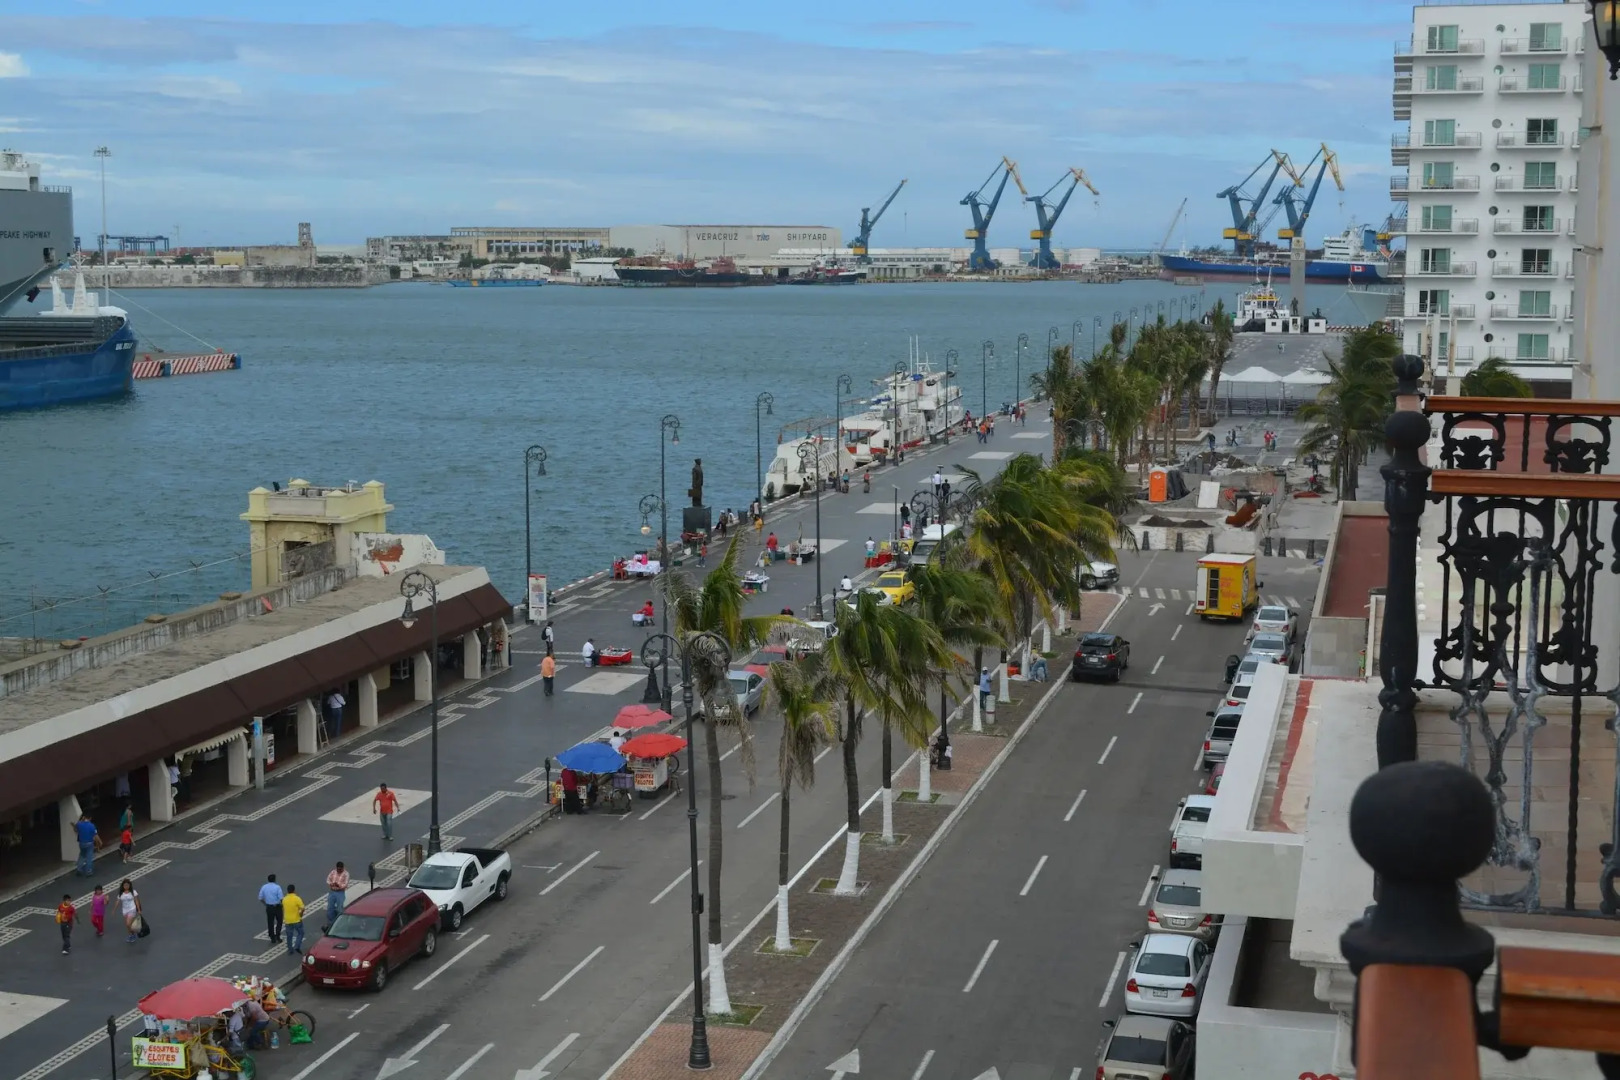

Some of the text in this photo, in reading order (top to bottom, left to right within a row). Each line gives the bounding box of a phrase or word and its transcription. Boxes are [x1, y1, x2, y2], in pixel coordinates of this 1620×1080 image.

[23, 230, 51, 239] HIGHWAY
[696, 233, 738, 241] VERACRUZ
[787, 233, 827, 241] SHIPYARD
[148, 1045, 180, 1053] ESQUITES
[147, 1053, 176, 1062] ELOTES
